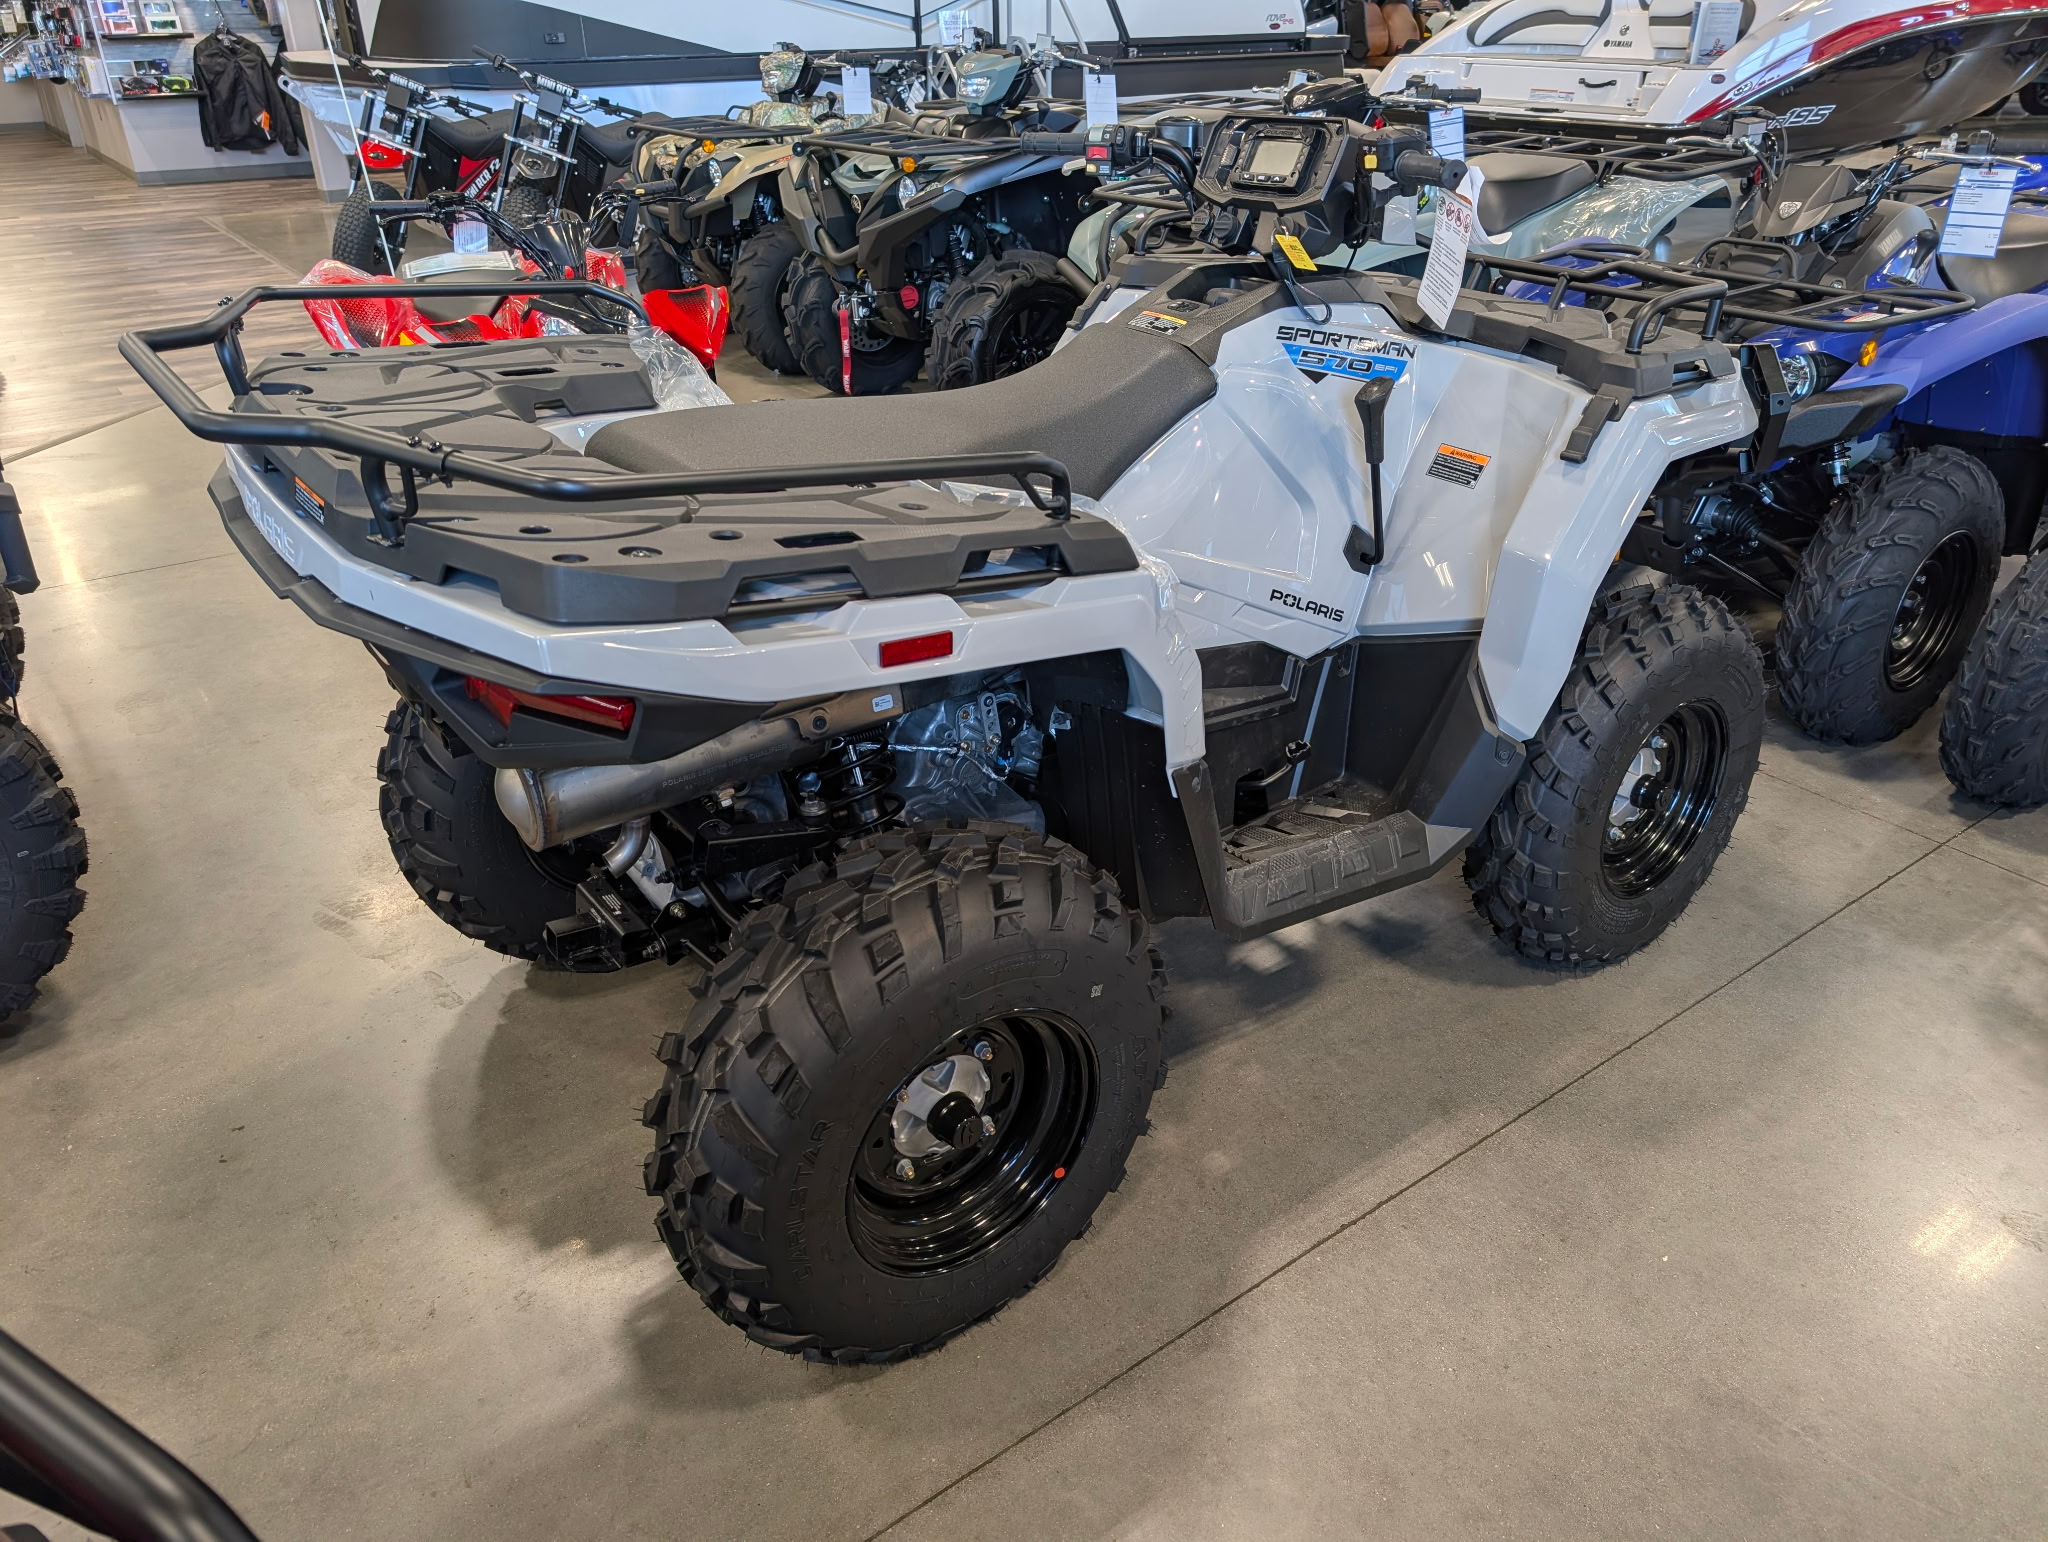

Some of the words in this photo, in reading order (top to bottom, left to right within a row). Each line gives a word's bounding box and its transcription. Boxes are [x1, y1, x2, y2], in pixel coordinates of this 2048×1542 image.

[1610, 40, 1633, 48] YAMAHA
[390, 73, 408, 88] MINI
[537, 75, 557, 91] MINI
[1767, 104, 1837, 129] R195
[1276, 326, 1418, 359] SPORTSMAN
[1298, 349, 1373, 374] 570
[1374, 363, 1398, 374] EFI
[1455, 451, 1477, 461] WARNING
[244, 484, 295, 563] POLARIS
[1269, 588, 1345, 623] POLARIS
[662, 772, 697, 788] POLARIS
[750, 743, 787, 760] QUALIFIED
[785, 1119, 834, 1283] CARLSTAR
